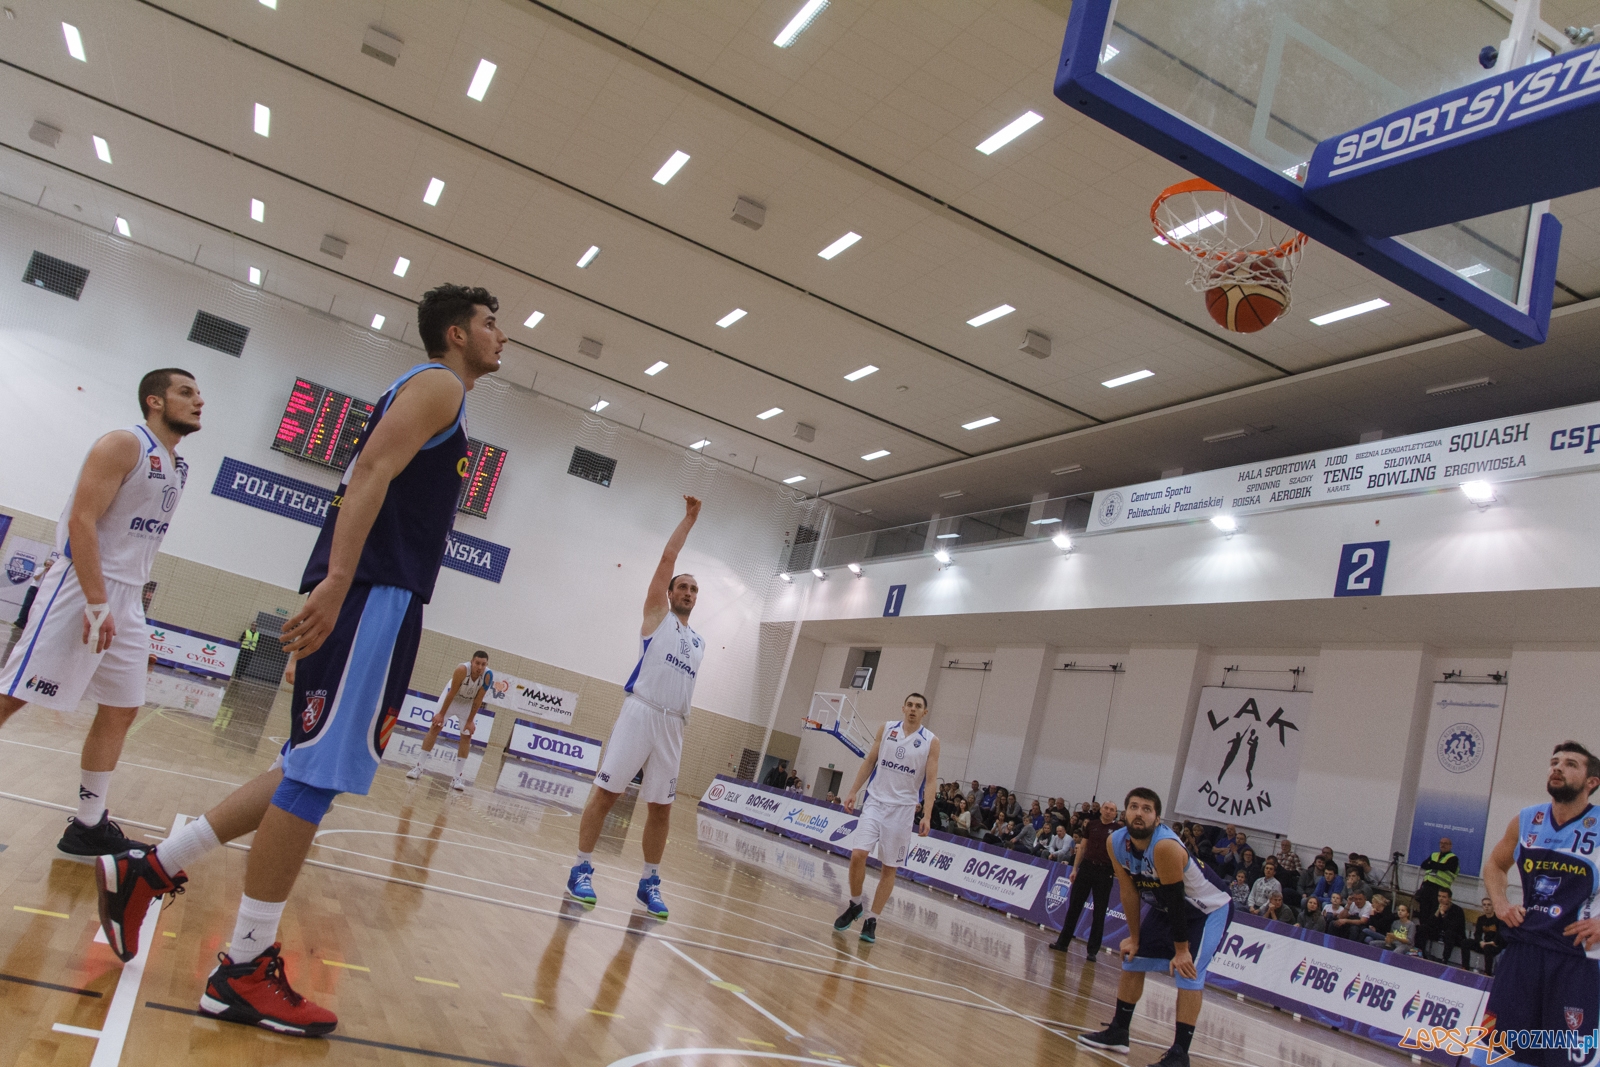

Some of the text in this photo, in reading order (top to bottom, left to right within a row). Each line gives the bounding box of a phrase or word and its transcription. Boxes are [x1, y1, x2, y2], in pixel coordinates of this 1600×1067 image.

[1449, 422, 1530, 453] SQUASH
[1325, 454, 1348, 467] JUDO
[1383, 453, 1432, 469] SIŁOWNIA
[1444, 454, 1526, 478] ERGOWIOSŁA
[1238, 459, 1316, 482] HALA SPORTOWA
[1323, 465, 1364, 484] TENIS
[1367, 465, 1437, 489] BOWLING
[1289, 475, 1314, 485] SZACHY
[1327, 484, 1351, 493] KARATE
[231, 472, 331, 517] POLITECH
[1131, 485, 1191, 502] Centrum Sportu
[1232, 495, 1261, 508] BOISKA
[1269, 486, 1312, 503] AEROBIK
[1127, 496, 1224, 519] Politechniki Poznańskiej
[444, 537, 491, 569] ŃSKA
[1347, 548, 1375, 590] 2
[888, 588, 898, 614] 1
[186, 652, 225, 668] CYMES
[34, 680, 58, 697] PBG
[522, 688, 563, 706] MAXXX
[550, 706, 572, 716] hitem
[895, 746, 906, 759] 8
[881, 759, 916, 775] BIOFARM
[710, 786, 722, 797] KIA
[746, 793, 780, 813] BIOFARM
[1198, 780, 1272, 816] POZNAŃ
[1571, 829, 1598, 855] 15
[912, 847, 931, 864] PBG
[935, 853, 953, 871] PBG
[963, 857, 1030, 890] BIOFARM
[1223, 959, 1247, 972] LEKÓW
[1310, 957, 1343, 973] fundacja
[1302, 965, 1340, 994] PBG
[1365, 974, 1400, 990] fundacja
[1357, 982, 1397, 1012] PBG
[1425, 991, 1465, 1009] fundacja
[1417, 999, 1461, 1029] PBG
